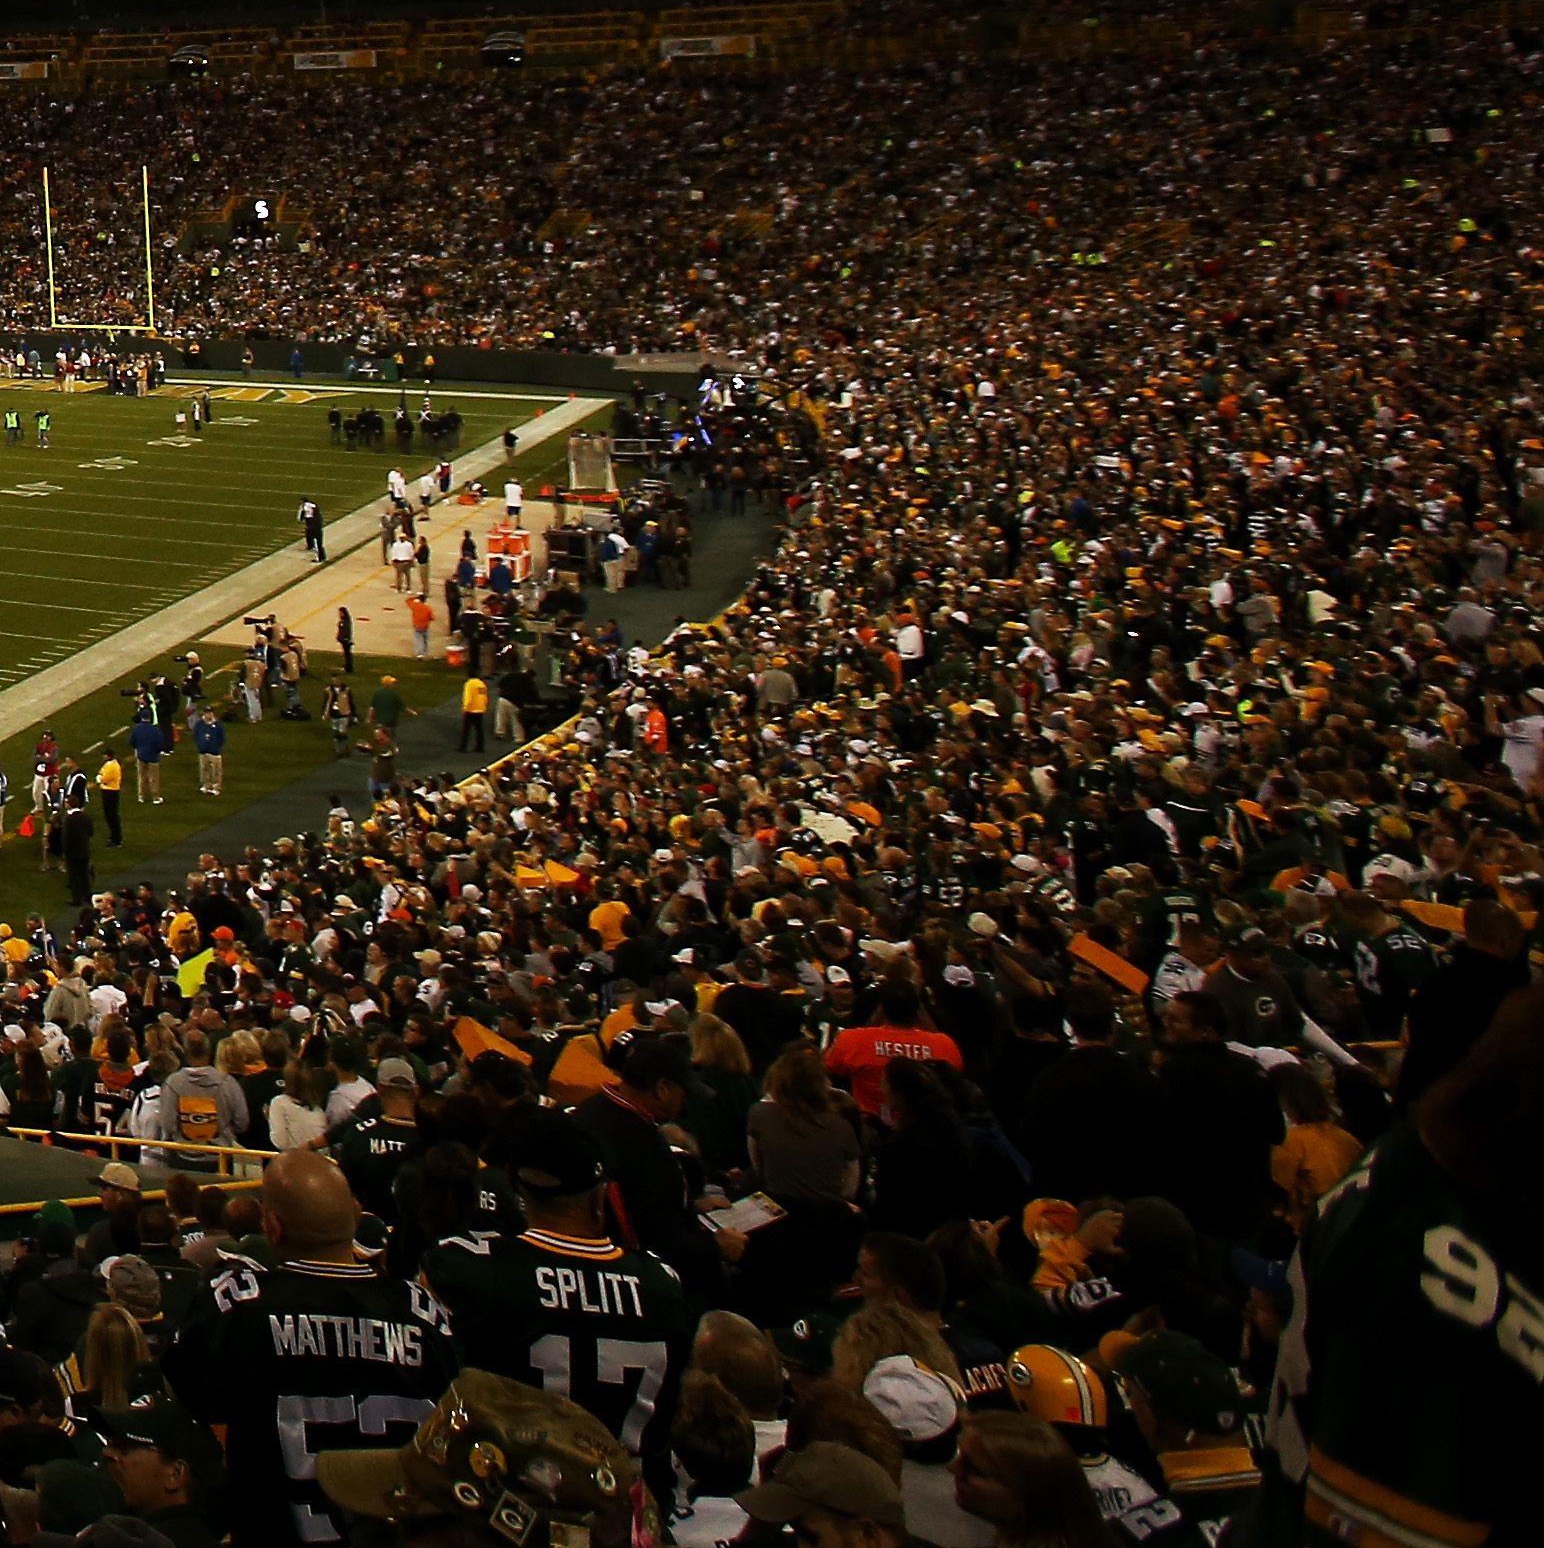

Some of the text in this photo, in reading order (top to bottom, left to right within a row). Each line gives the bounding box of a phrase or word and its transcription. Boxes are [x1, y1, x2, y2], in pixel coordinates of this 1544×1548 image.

[873, 1040, 931, 1061] HESTER
[535, 1265, 644, 1317] SPLITT
[268, 1313, 424, 1369] MATTHEWS
[529, 1333, 668, 1456] 17
